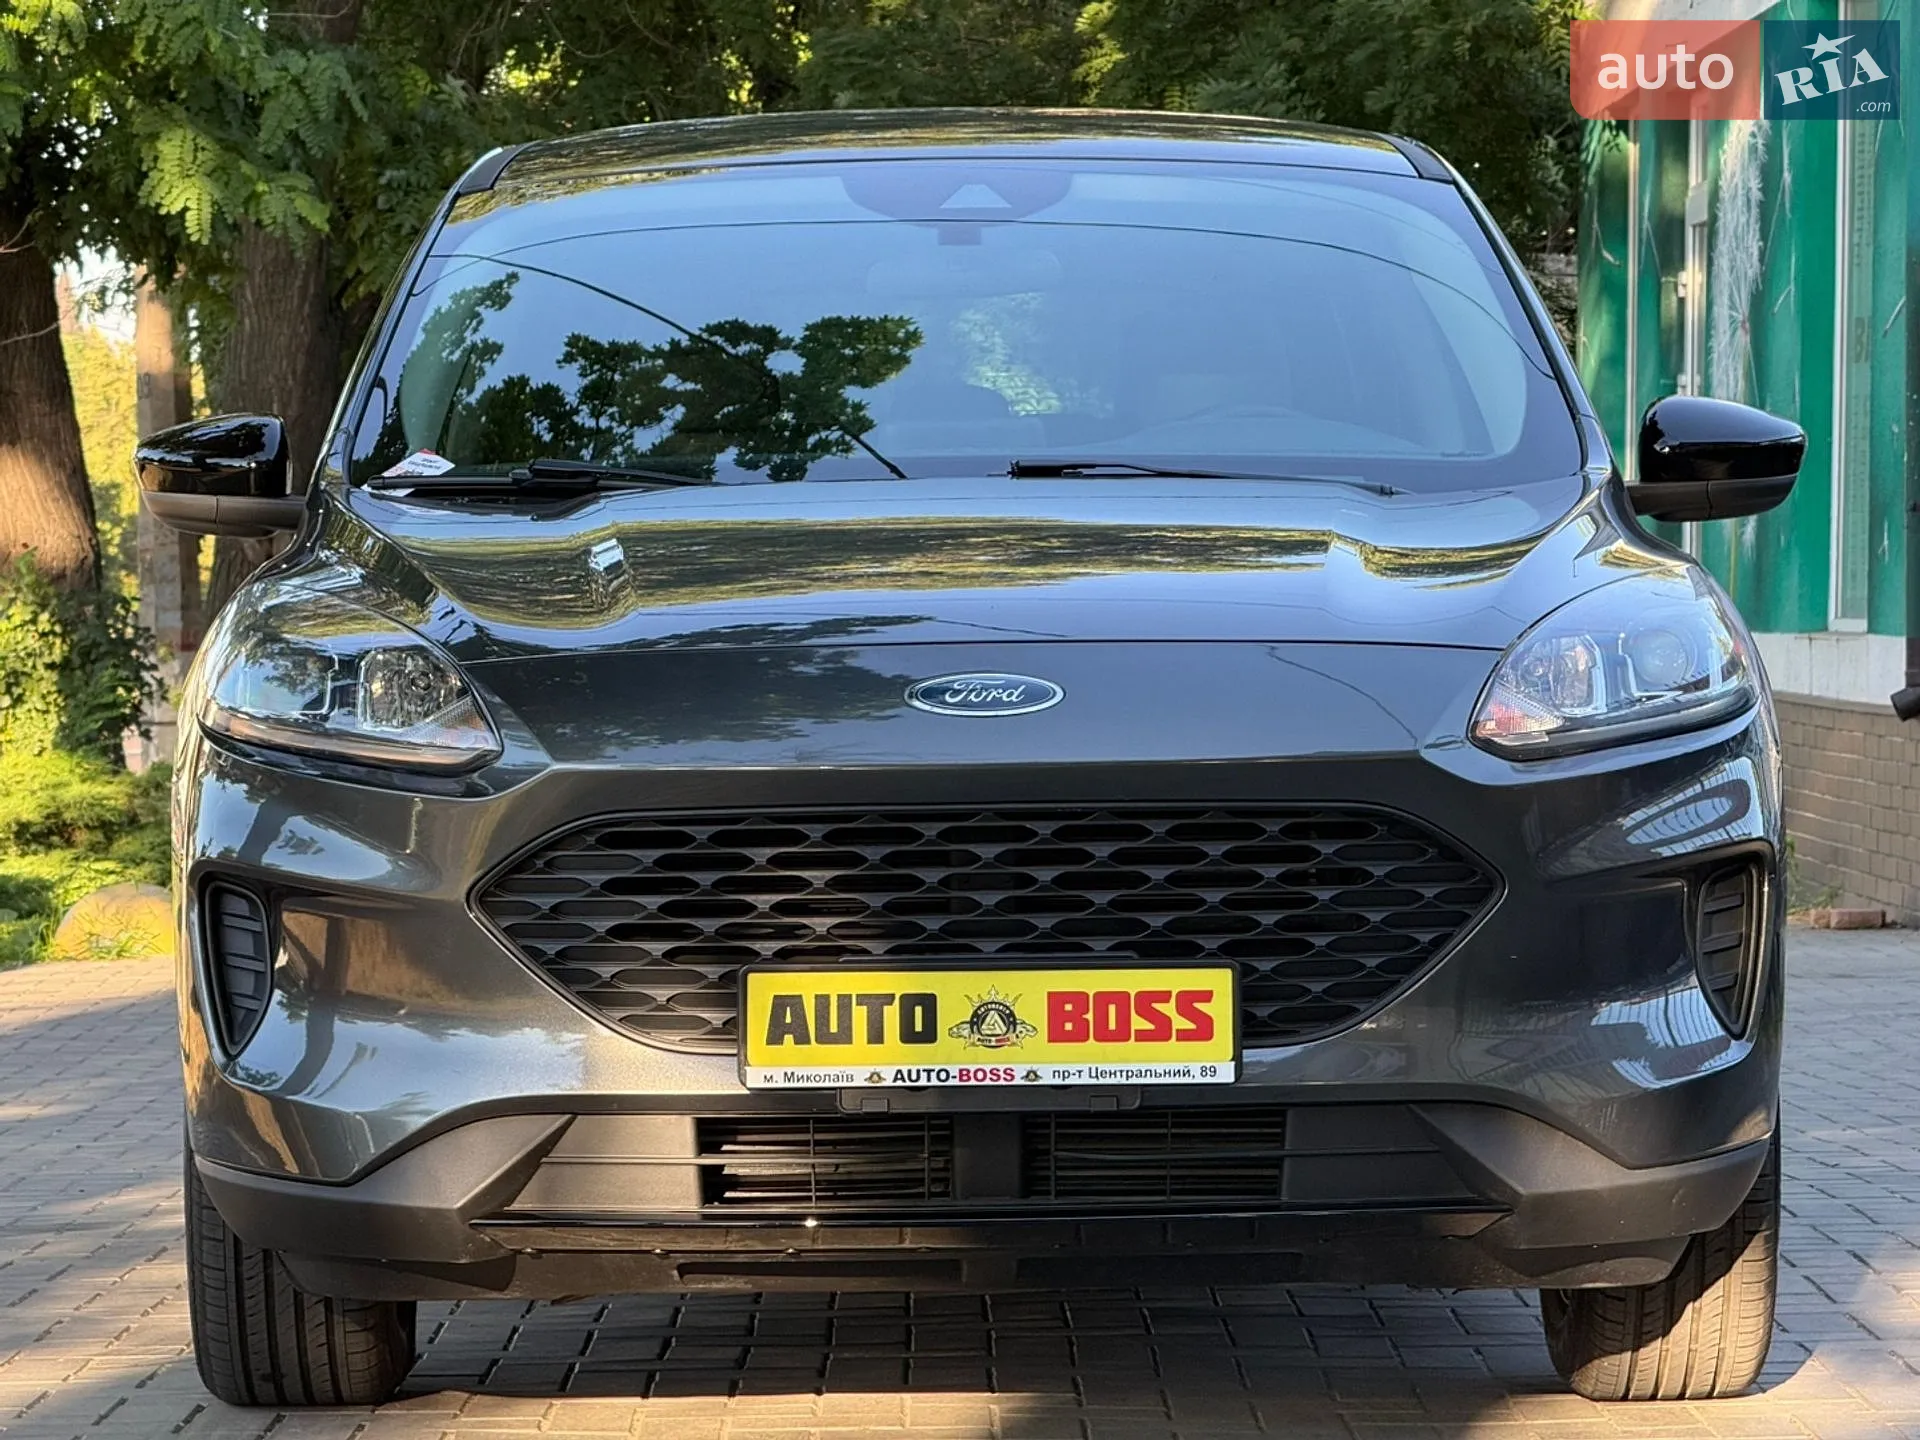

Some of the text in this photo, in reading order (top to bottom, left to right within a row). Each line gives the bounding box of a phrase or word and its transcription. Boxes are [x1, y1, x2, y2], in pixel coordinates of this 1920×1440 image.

[944, 679, 1027, 704] Ford
[765, 989, 1214, 1046] AUTO BOSS
[763, 1070, 855, 1084] м. Миколаїв
[892, 1067, 1016, 1084] AUTO-BOSS
[1052, 1065, 1218, 1081] пр-т Центральний, 89
